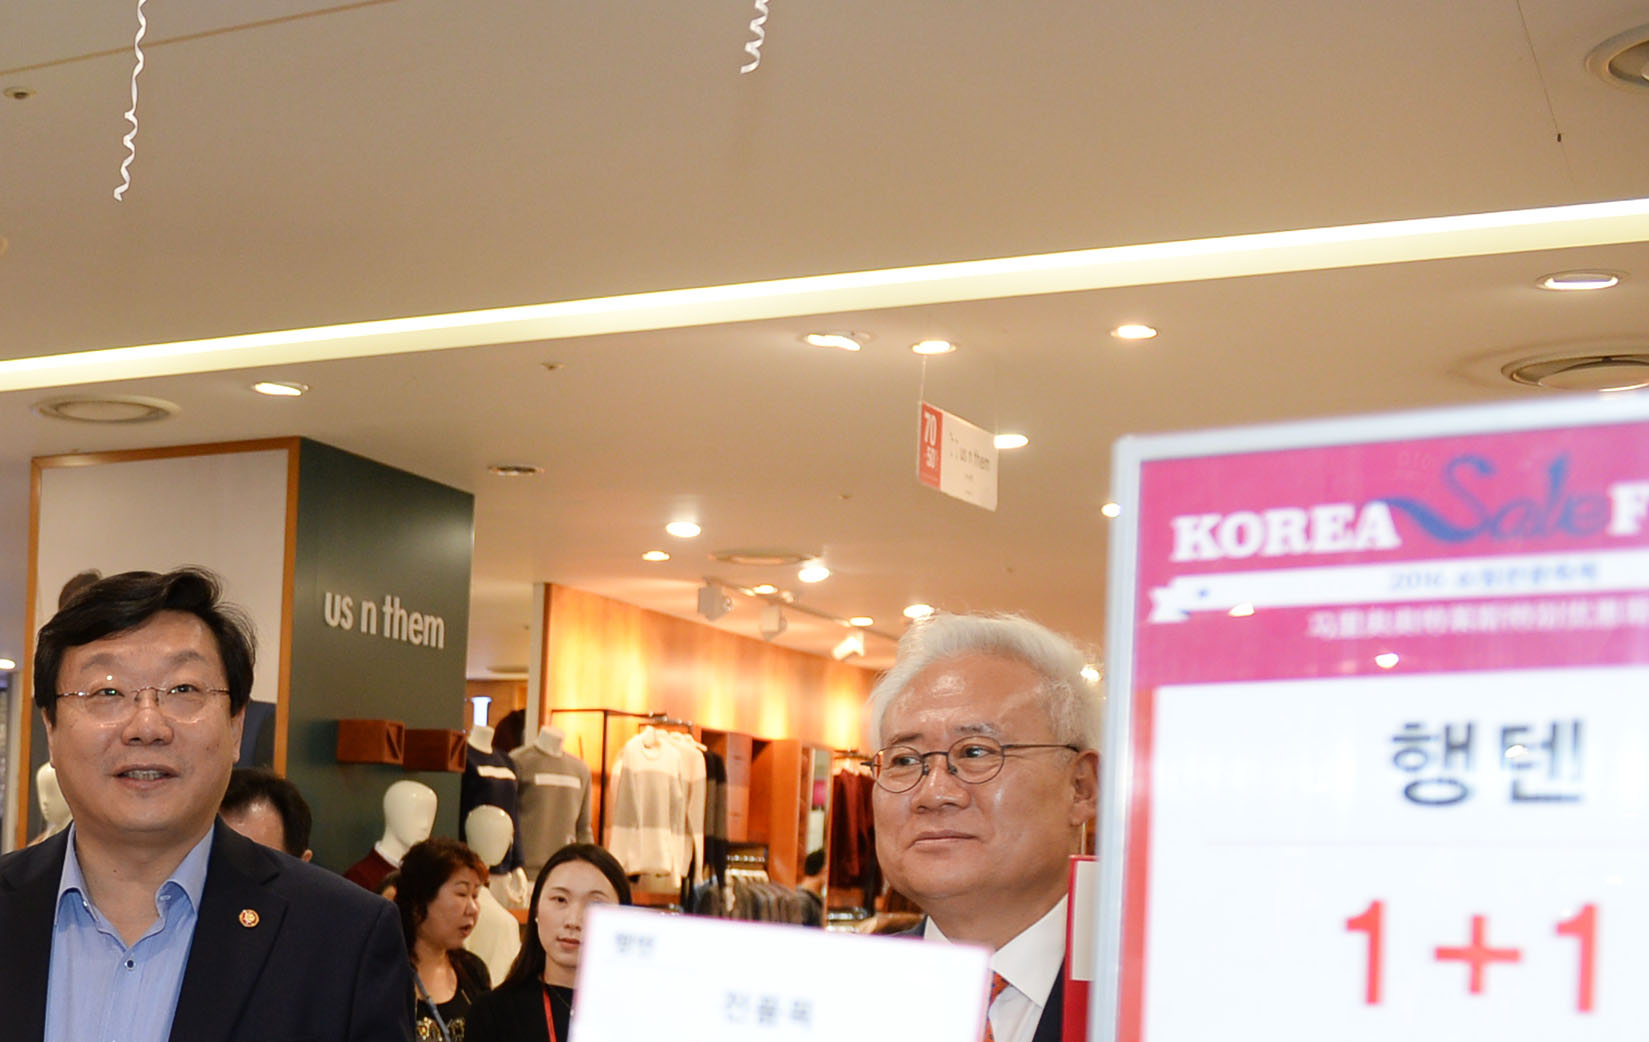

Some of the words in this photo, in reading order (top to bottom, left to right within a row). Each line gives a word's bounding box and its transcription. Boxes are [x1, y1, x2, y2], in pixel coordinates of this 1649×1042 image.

[1170, 502, 1402, 564] KOREA
[1367, 452, 1610, 543] Sale
[324, 591, 353, 631] us
[360, 600, 377, 636] n
[383, 595, 445, 650] them
[1389, 720, 1584, 807] 행텐
[1344, 899, 1599, 1014] 1+1
